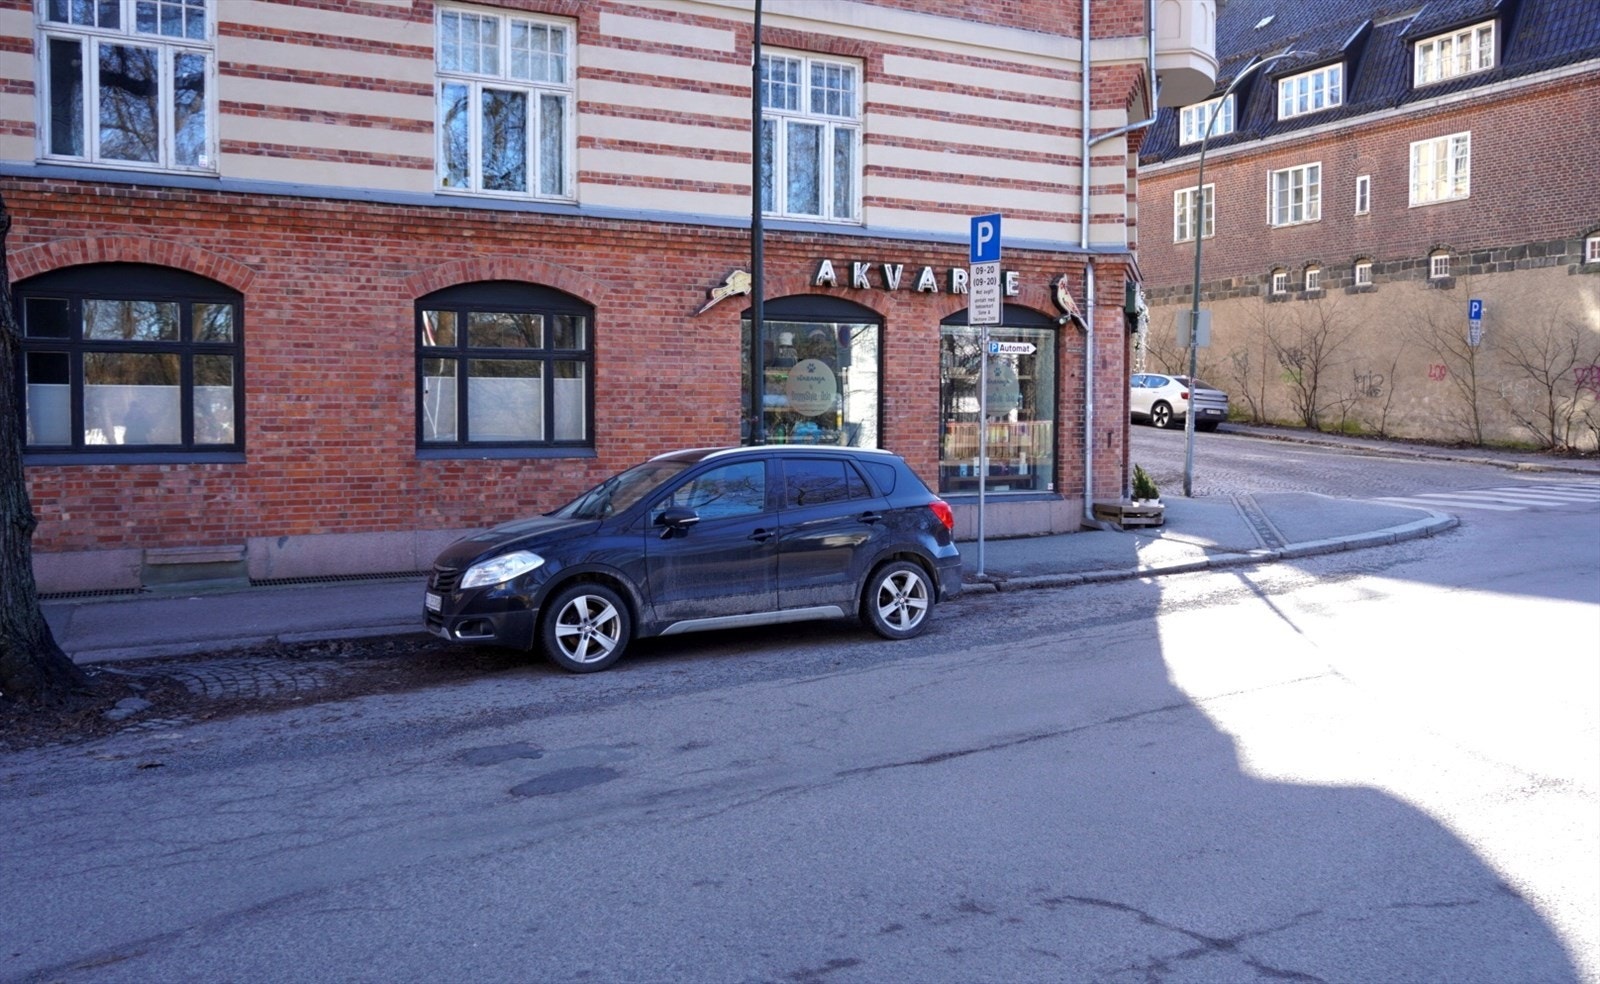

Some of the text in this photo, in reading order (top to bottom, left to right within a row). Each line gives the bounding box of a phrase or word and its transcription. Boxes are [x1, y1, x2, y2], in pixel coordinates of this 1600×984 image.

[977, 221, 994, 257] P
[975, 266, 995, 275] 09-20
[813, 259, 1020, 296] AKVARE
[973, 277, 997, 287] (09-20)
[1471, 302, 1480, 318] P
[1000, 344, 1030, 352] Automat
